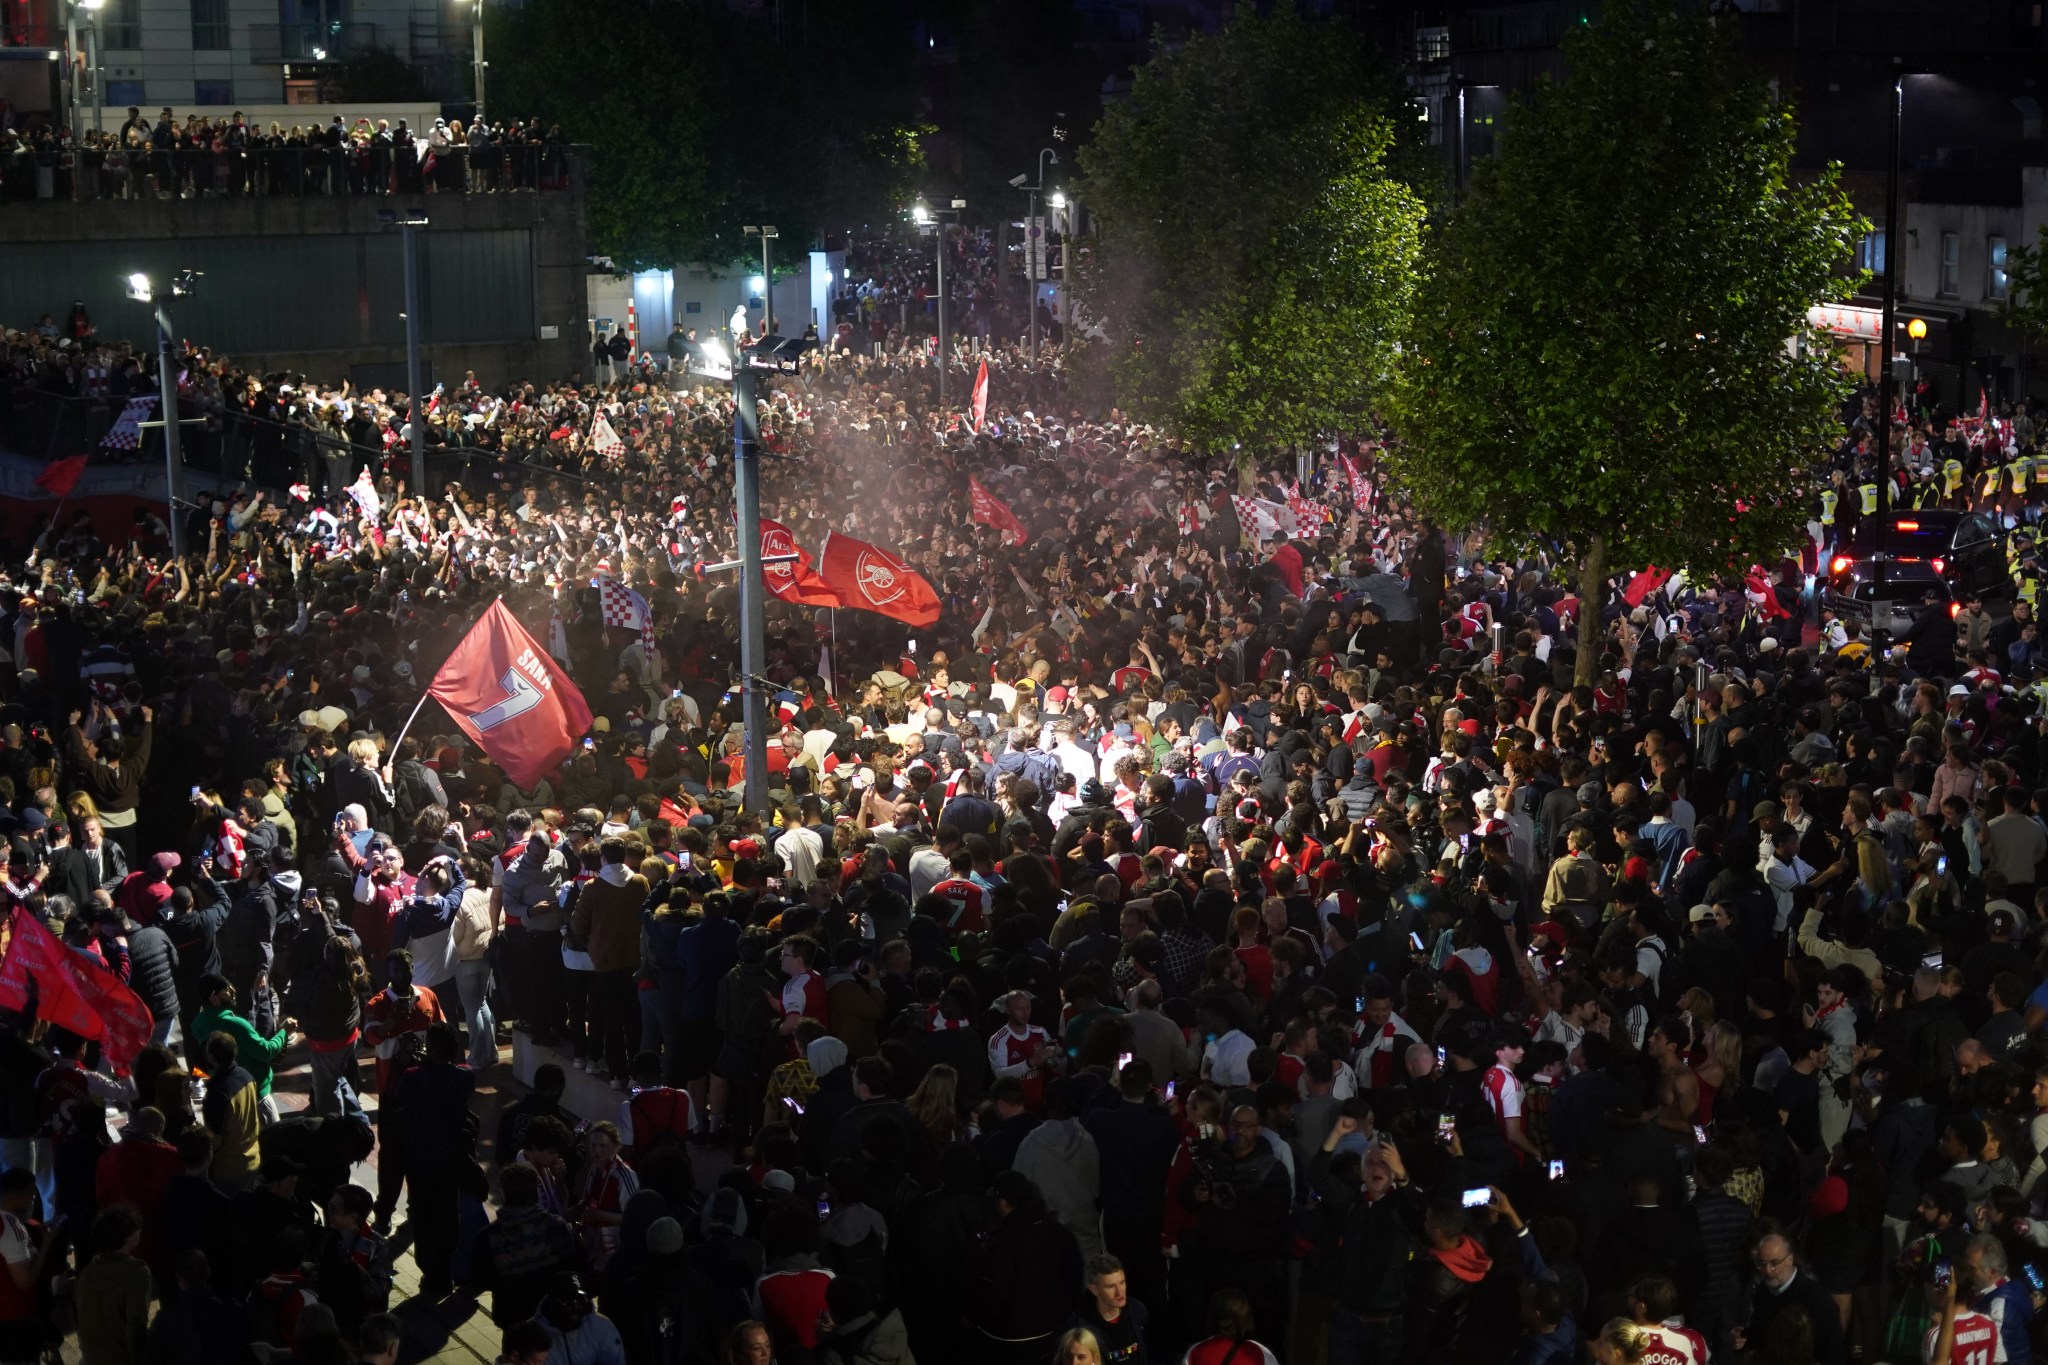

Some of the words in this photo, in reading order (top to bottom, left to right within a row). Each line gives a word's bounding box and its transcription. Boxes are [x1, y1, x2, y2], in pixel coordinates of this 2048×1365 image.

[467, 665, 544, 733] 7
[947, 887, 968, 896] SAKA
[947, 898, 966, 927] 7
[1965, 1347, 1989, 1365] 11
